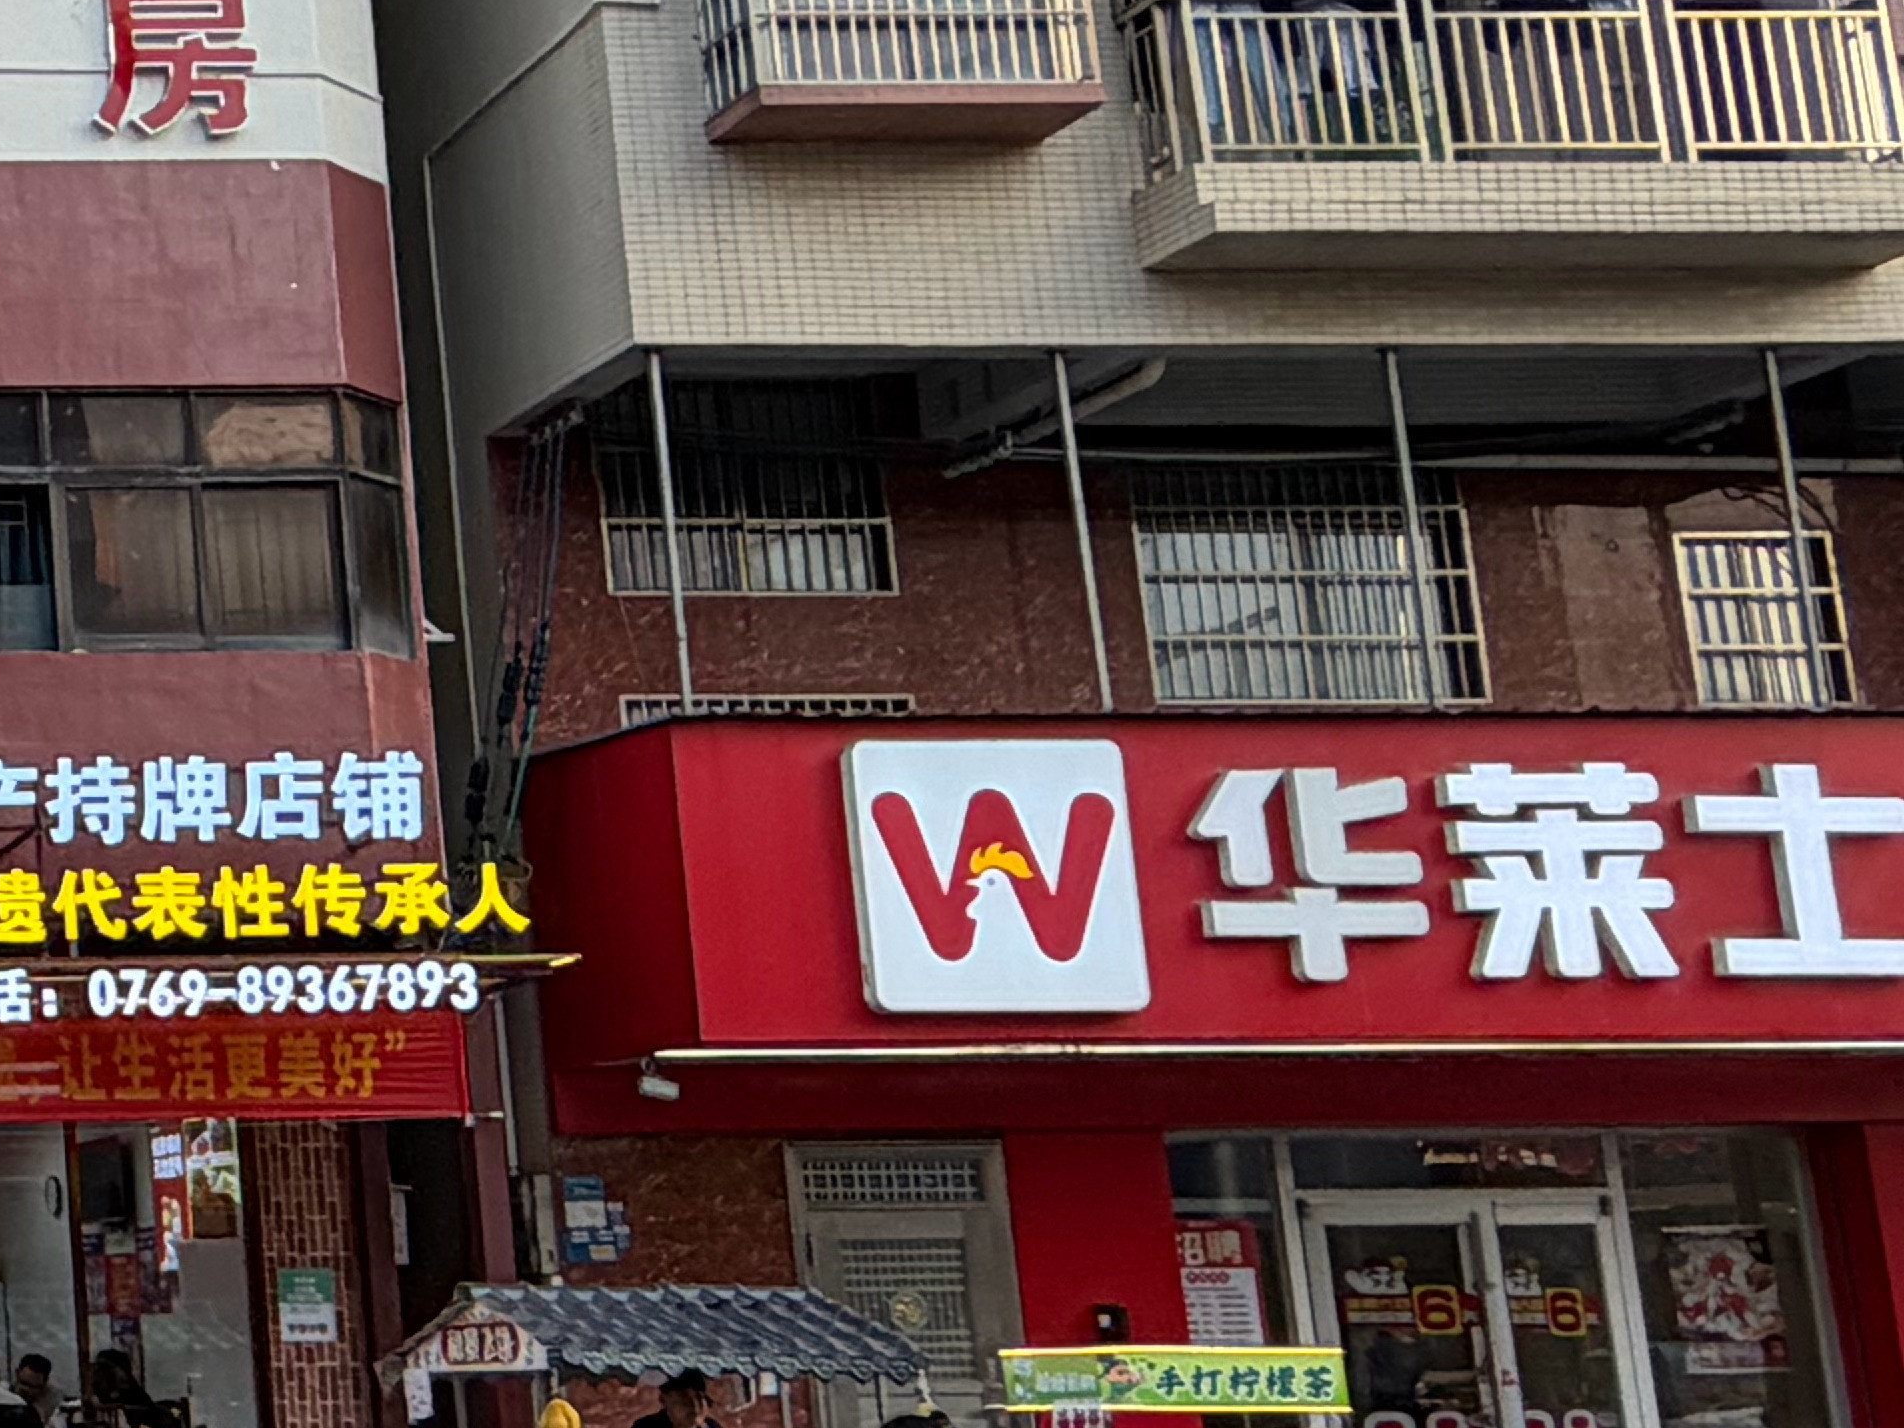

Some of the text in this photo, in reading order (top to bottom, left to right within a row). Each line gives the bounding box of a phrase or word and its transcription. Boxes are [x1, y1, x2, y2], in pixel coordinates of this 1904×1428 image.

[1187, 763, 1904, 980] 华莱士
[1155, 1365, 1335, 1401] 手打柠檬茶
